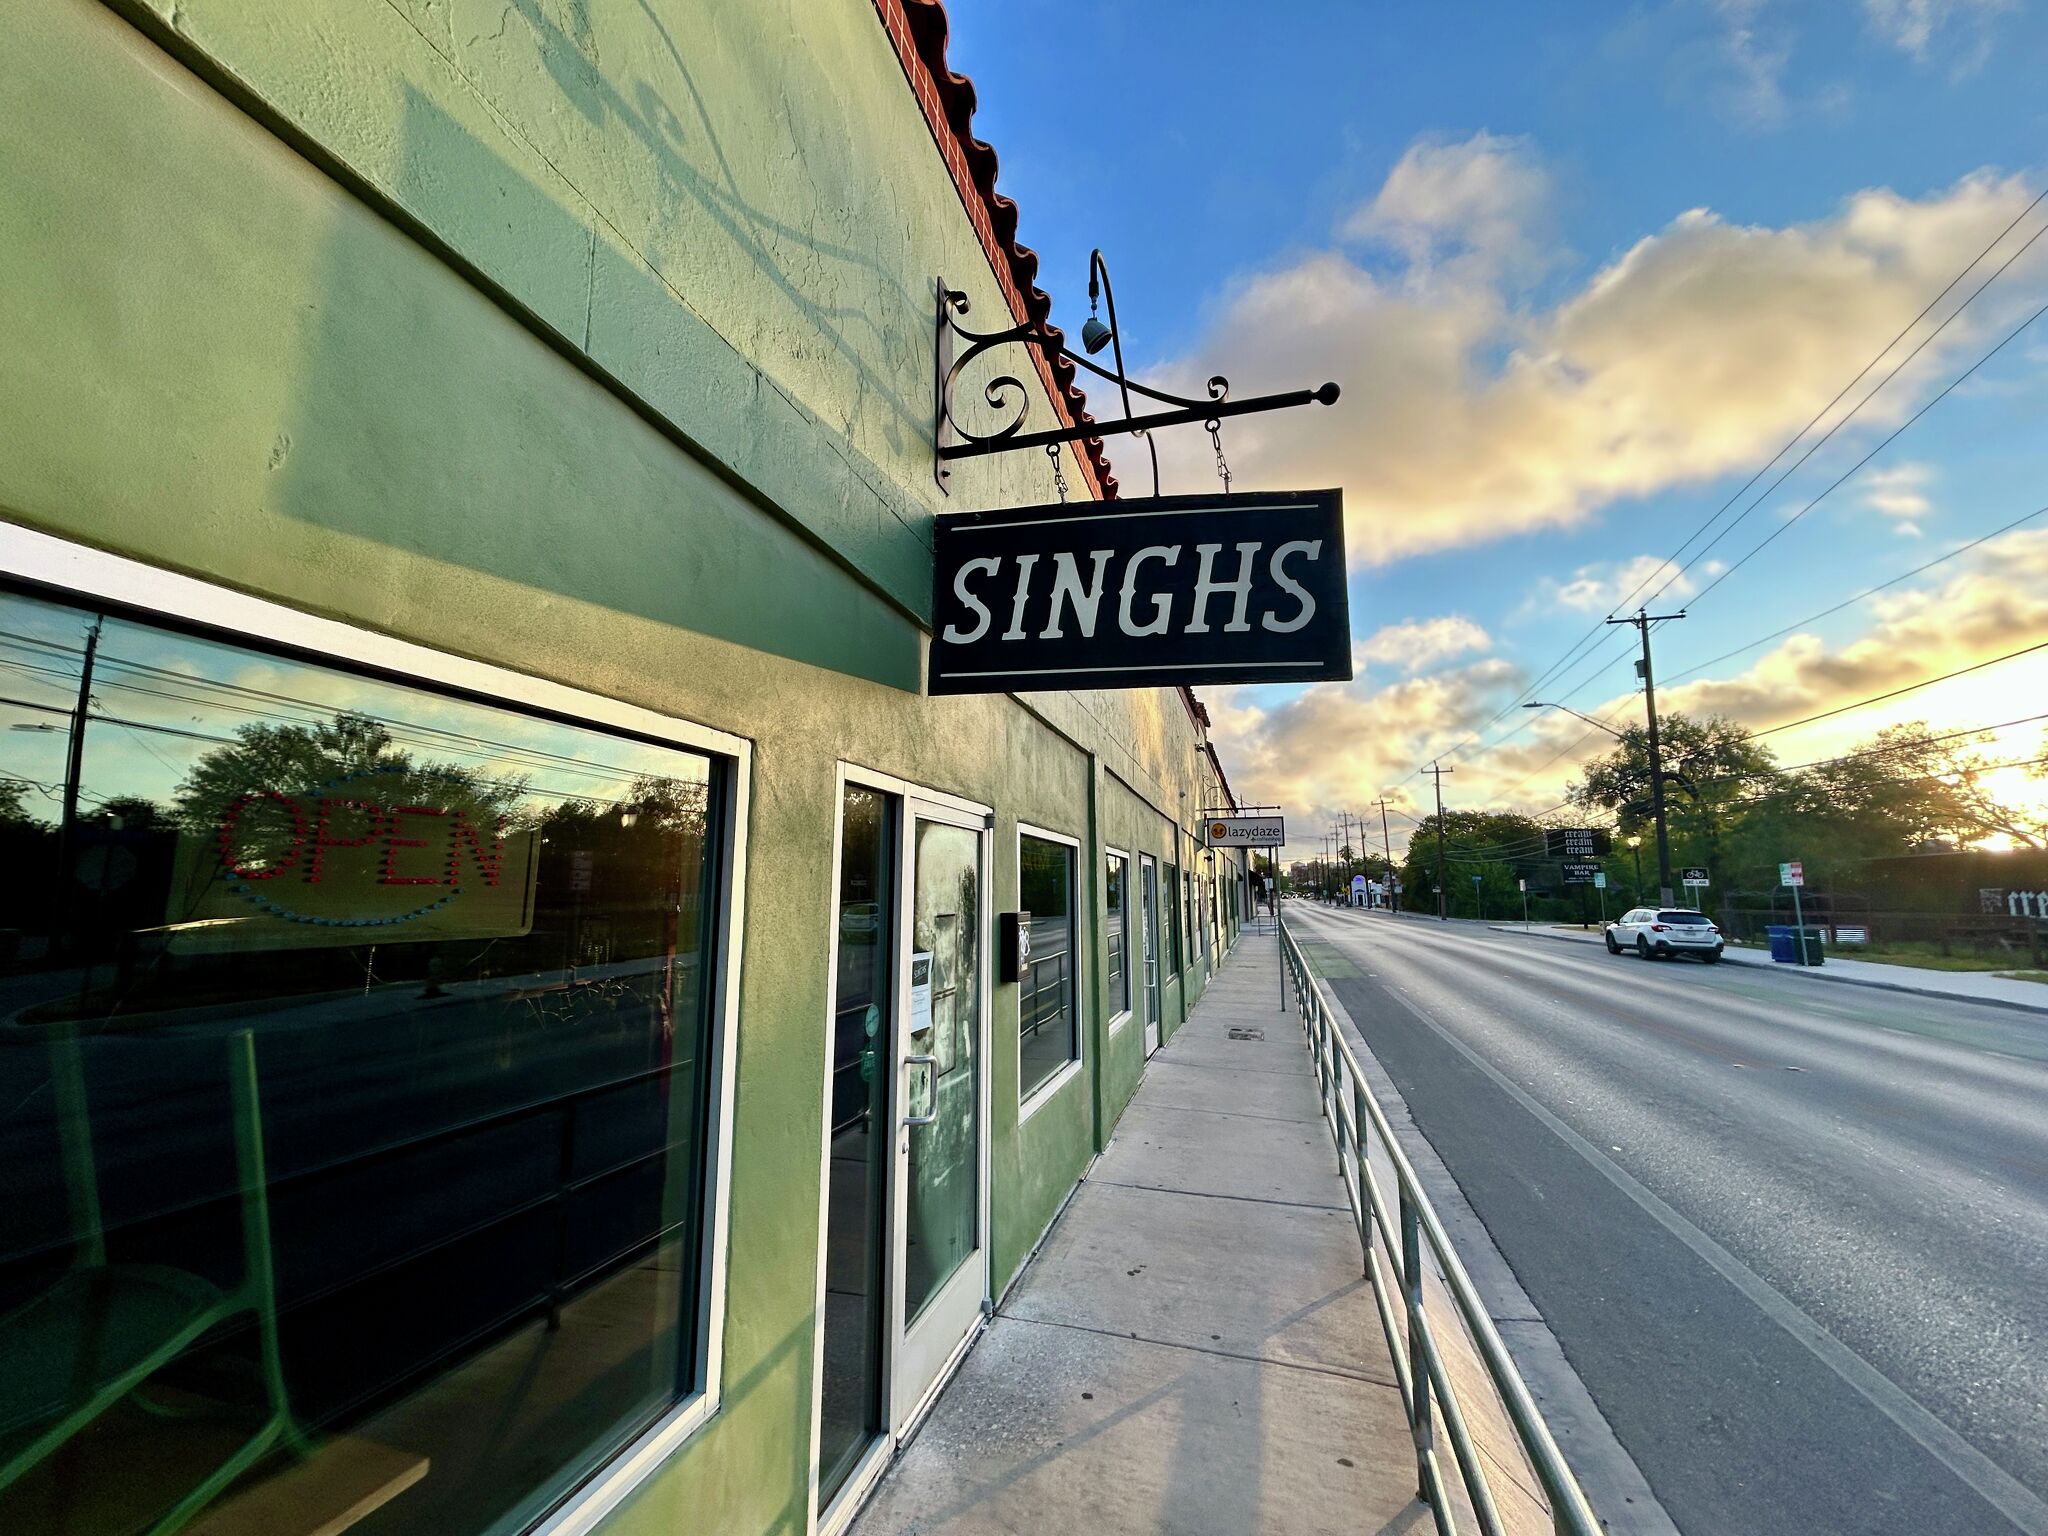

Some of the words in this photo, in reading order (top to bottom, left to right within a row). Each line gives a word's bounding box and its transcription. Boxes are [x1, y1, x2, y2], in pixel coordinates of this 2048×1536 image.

[942, 539, 1322, 645] SINGHS
[216, 790, 506, 885] OPEN
[1228, 826, 1280, 839] lazydaze
[1564, 830, 1592, 838] cream
[1565, 838, 1593, 846] cream
[1566, 846, 1594, 854] cream
